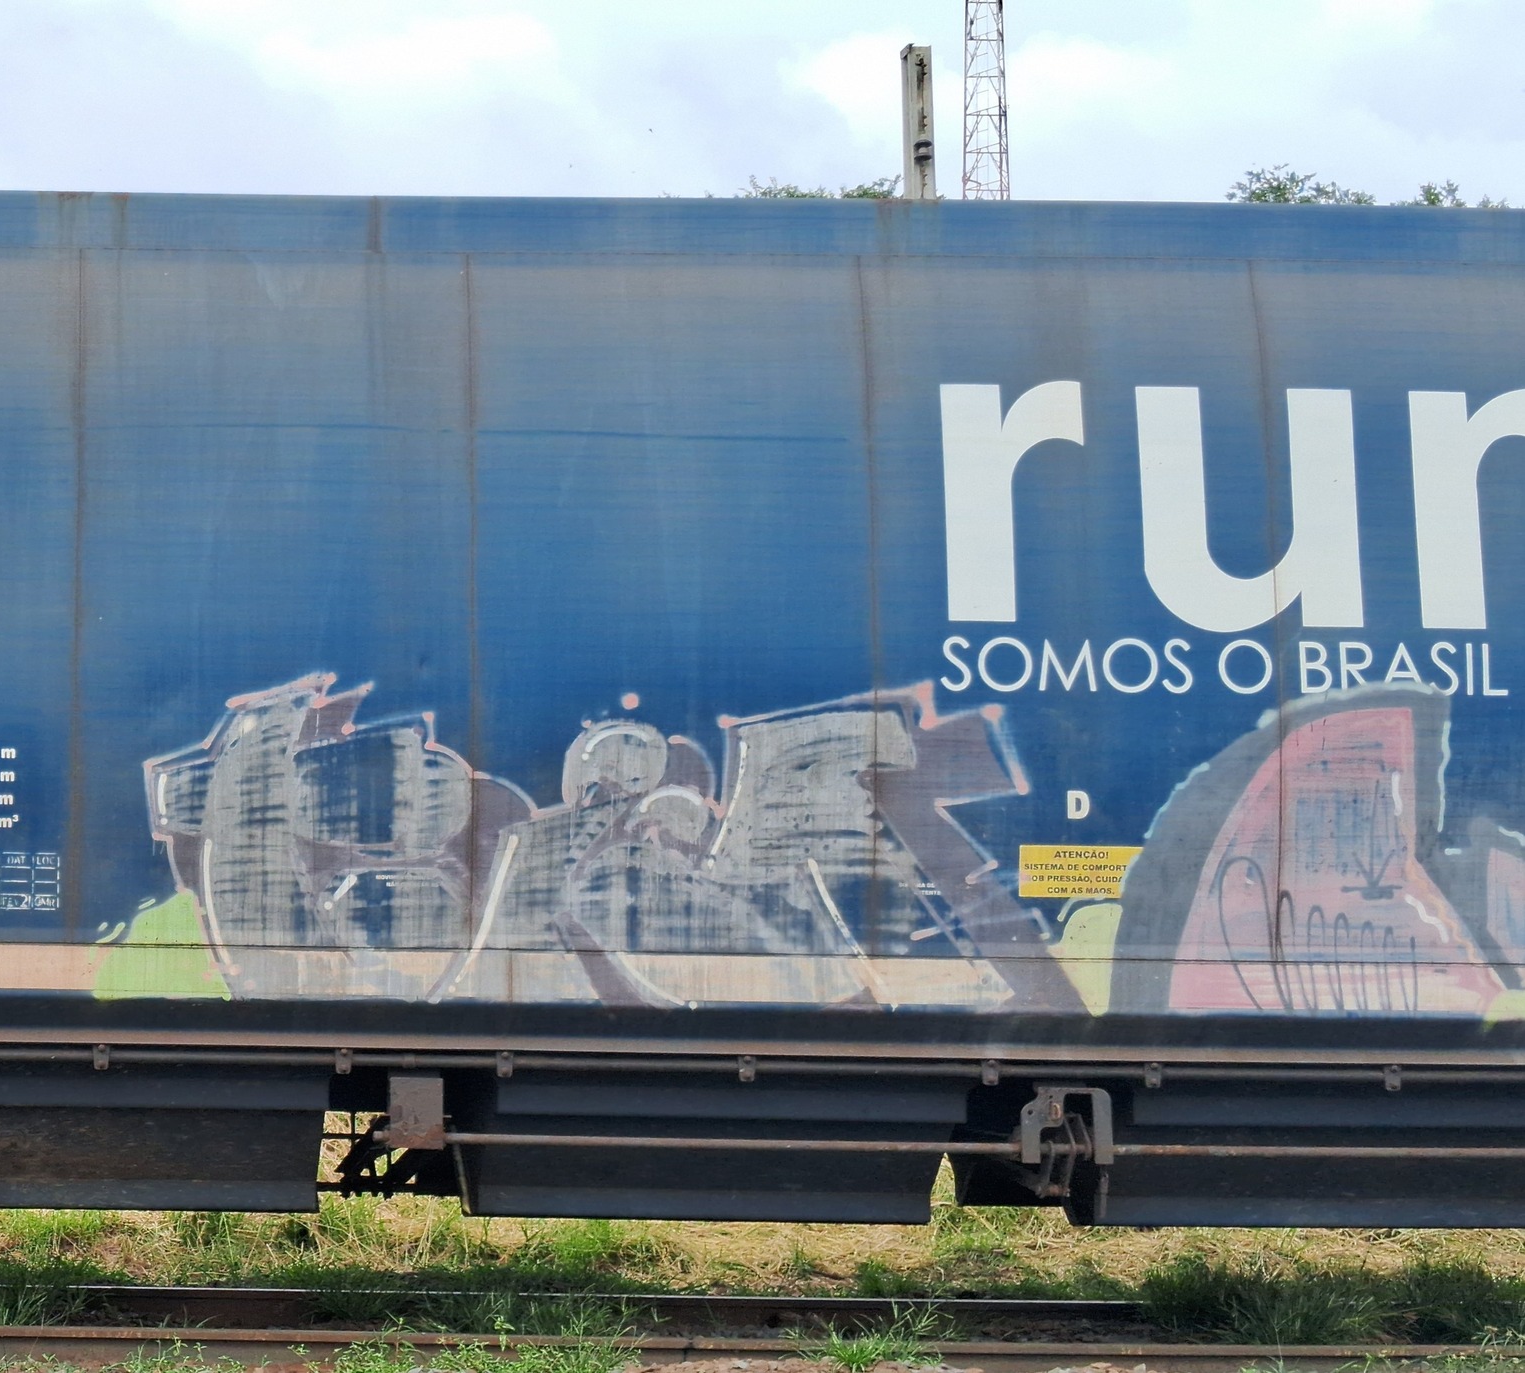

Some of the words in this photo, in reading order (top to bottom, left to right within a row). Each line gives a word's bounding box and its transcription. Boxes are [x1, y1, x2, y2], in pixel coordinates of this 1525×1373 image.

[941, 636, 1193, 693] SOMOS
[1218, 638, 1272, 693] O
[1299, 640, 1509, 696] BRASIL
[1, 748, 16, 759] m
[0, 771, 15, 782] m
[0, 794, 14, 805] m
[1067, 790, 1091, 819] D
[1054, 850, 1109, 859] ATENÇÃO!
[36, 856, 55, 865] LOC
[1024, 863, 1064, 871] SISTEMA
